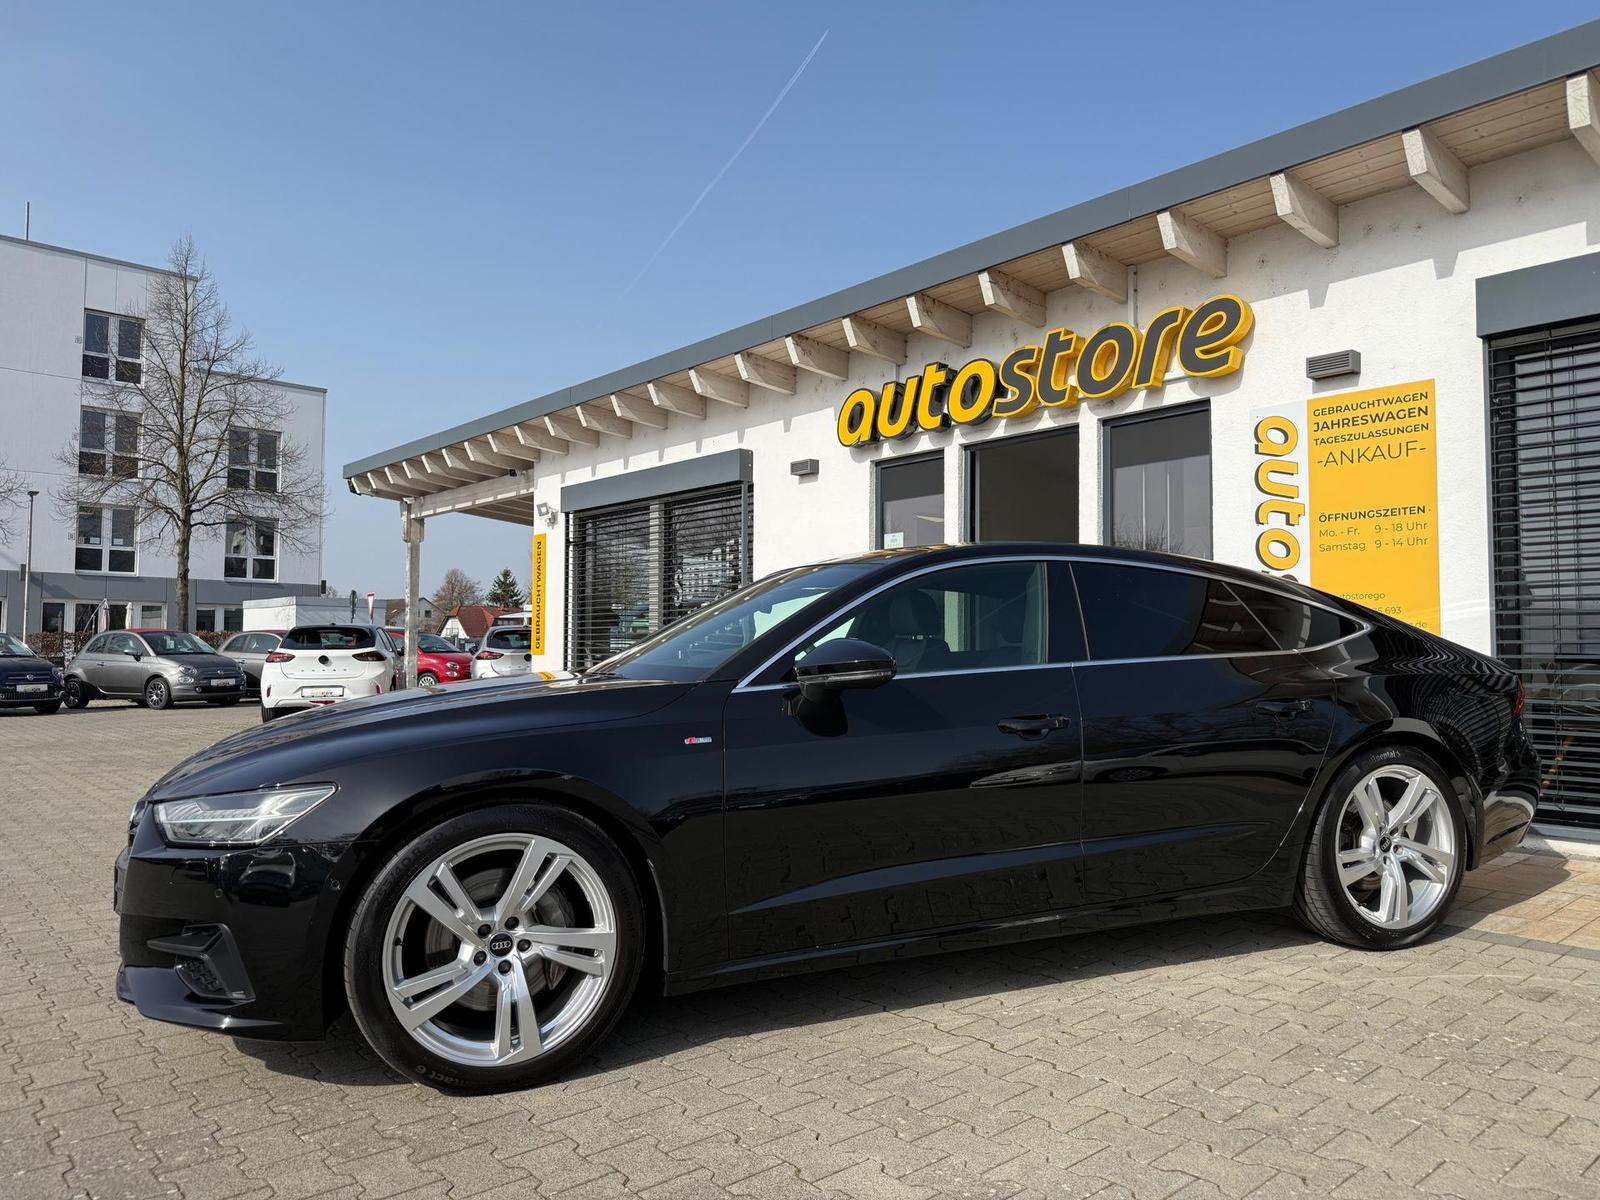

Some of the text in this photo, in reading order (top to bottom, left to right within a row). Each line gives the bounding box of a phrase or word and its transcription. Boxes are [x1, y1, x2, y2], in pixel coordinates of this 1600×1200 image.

[837, 294, 1257, 448] autostore
[1313, 391, 1428, 417] GEBRAUCHTWAGEN
[1313, 405, 1428, 433] JAHRESWAGEN
[1313, 422, 1429, 446] TAGESZULASSUNGEN
[1254, 415, 1306, 582] auto
[1318, 505, 1426, 523] ÖFFNUNGSZEITEN
[1319, 529, 1338, 538] Mo.
[1347, 526, 1360, 536] Fr.
[1374, 524, 1382, 534] 9
[1392, 522, 1403, 532] 18
[1406, 521, 1428, 532] Uhr
[1319, 541, 1366, 552] Samstag
[1374, 539, 1382, 549] 9
[1392, 537, 1403, 547] 14
[1406, 536, 1429, 547] Uhr
[534, 541, 542, 649] GEBRAUCHTWAGEN
